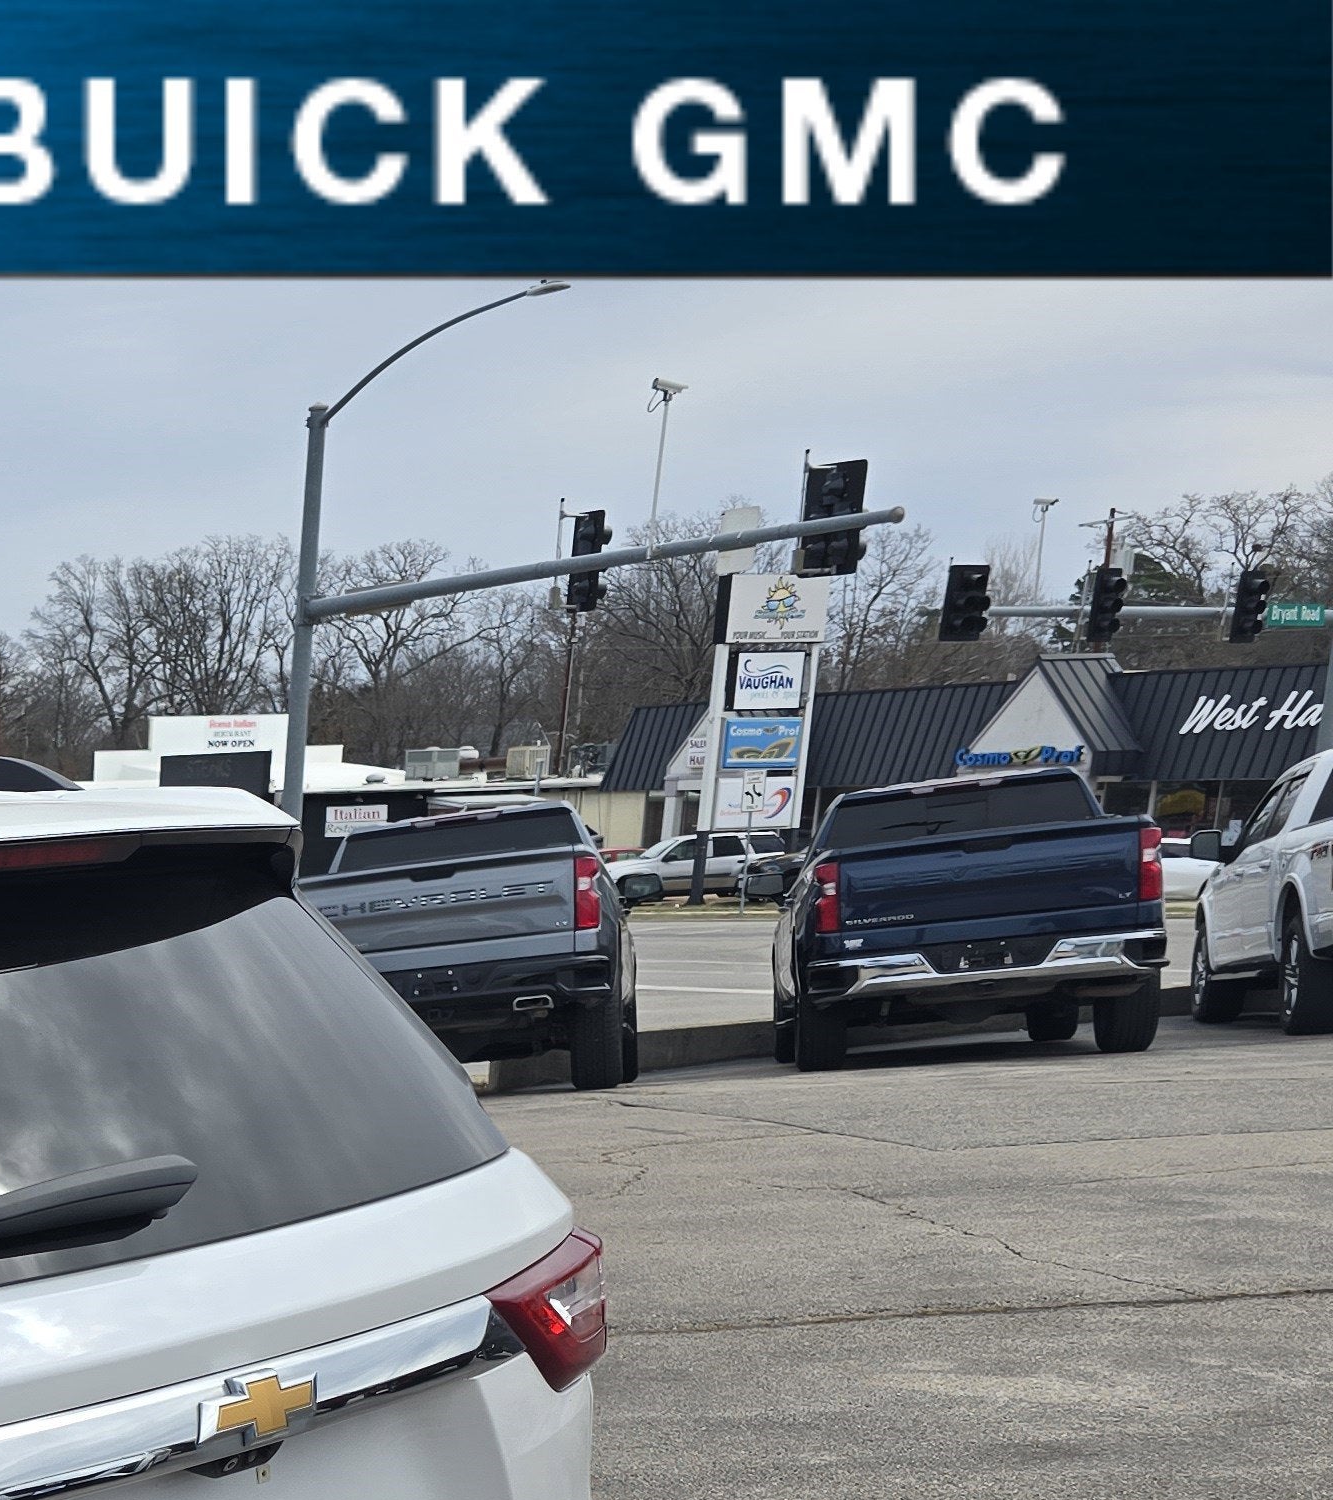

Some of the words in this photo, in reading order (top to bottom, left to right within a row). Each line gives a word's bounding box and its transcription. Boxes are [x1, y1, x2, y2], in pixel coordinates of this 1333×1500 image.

[1271, 605, 1298, 623] Bryant
[1300, 605, 1321, 621] Road
[738, 675, 794, 690] VAUGHAN
[1178, 693, 1268, 735] West
[730, 725, 763, 736] Cosmo
[778, 725, 800, 736] Prof
[207, 740, 227, 748] NOW
[231, 739, 255, 747] OPEN
[955, 747, 1011, 766] Cosmo
[1040, 745, 1085, 763] Prof
[334, 808, 380, 820] Italian
[318, 880, 554, 919] CHEVROLET
